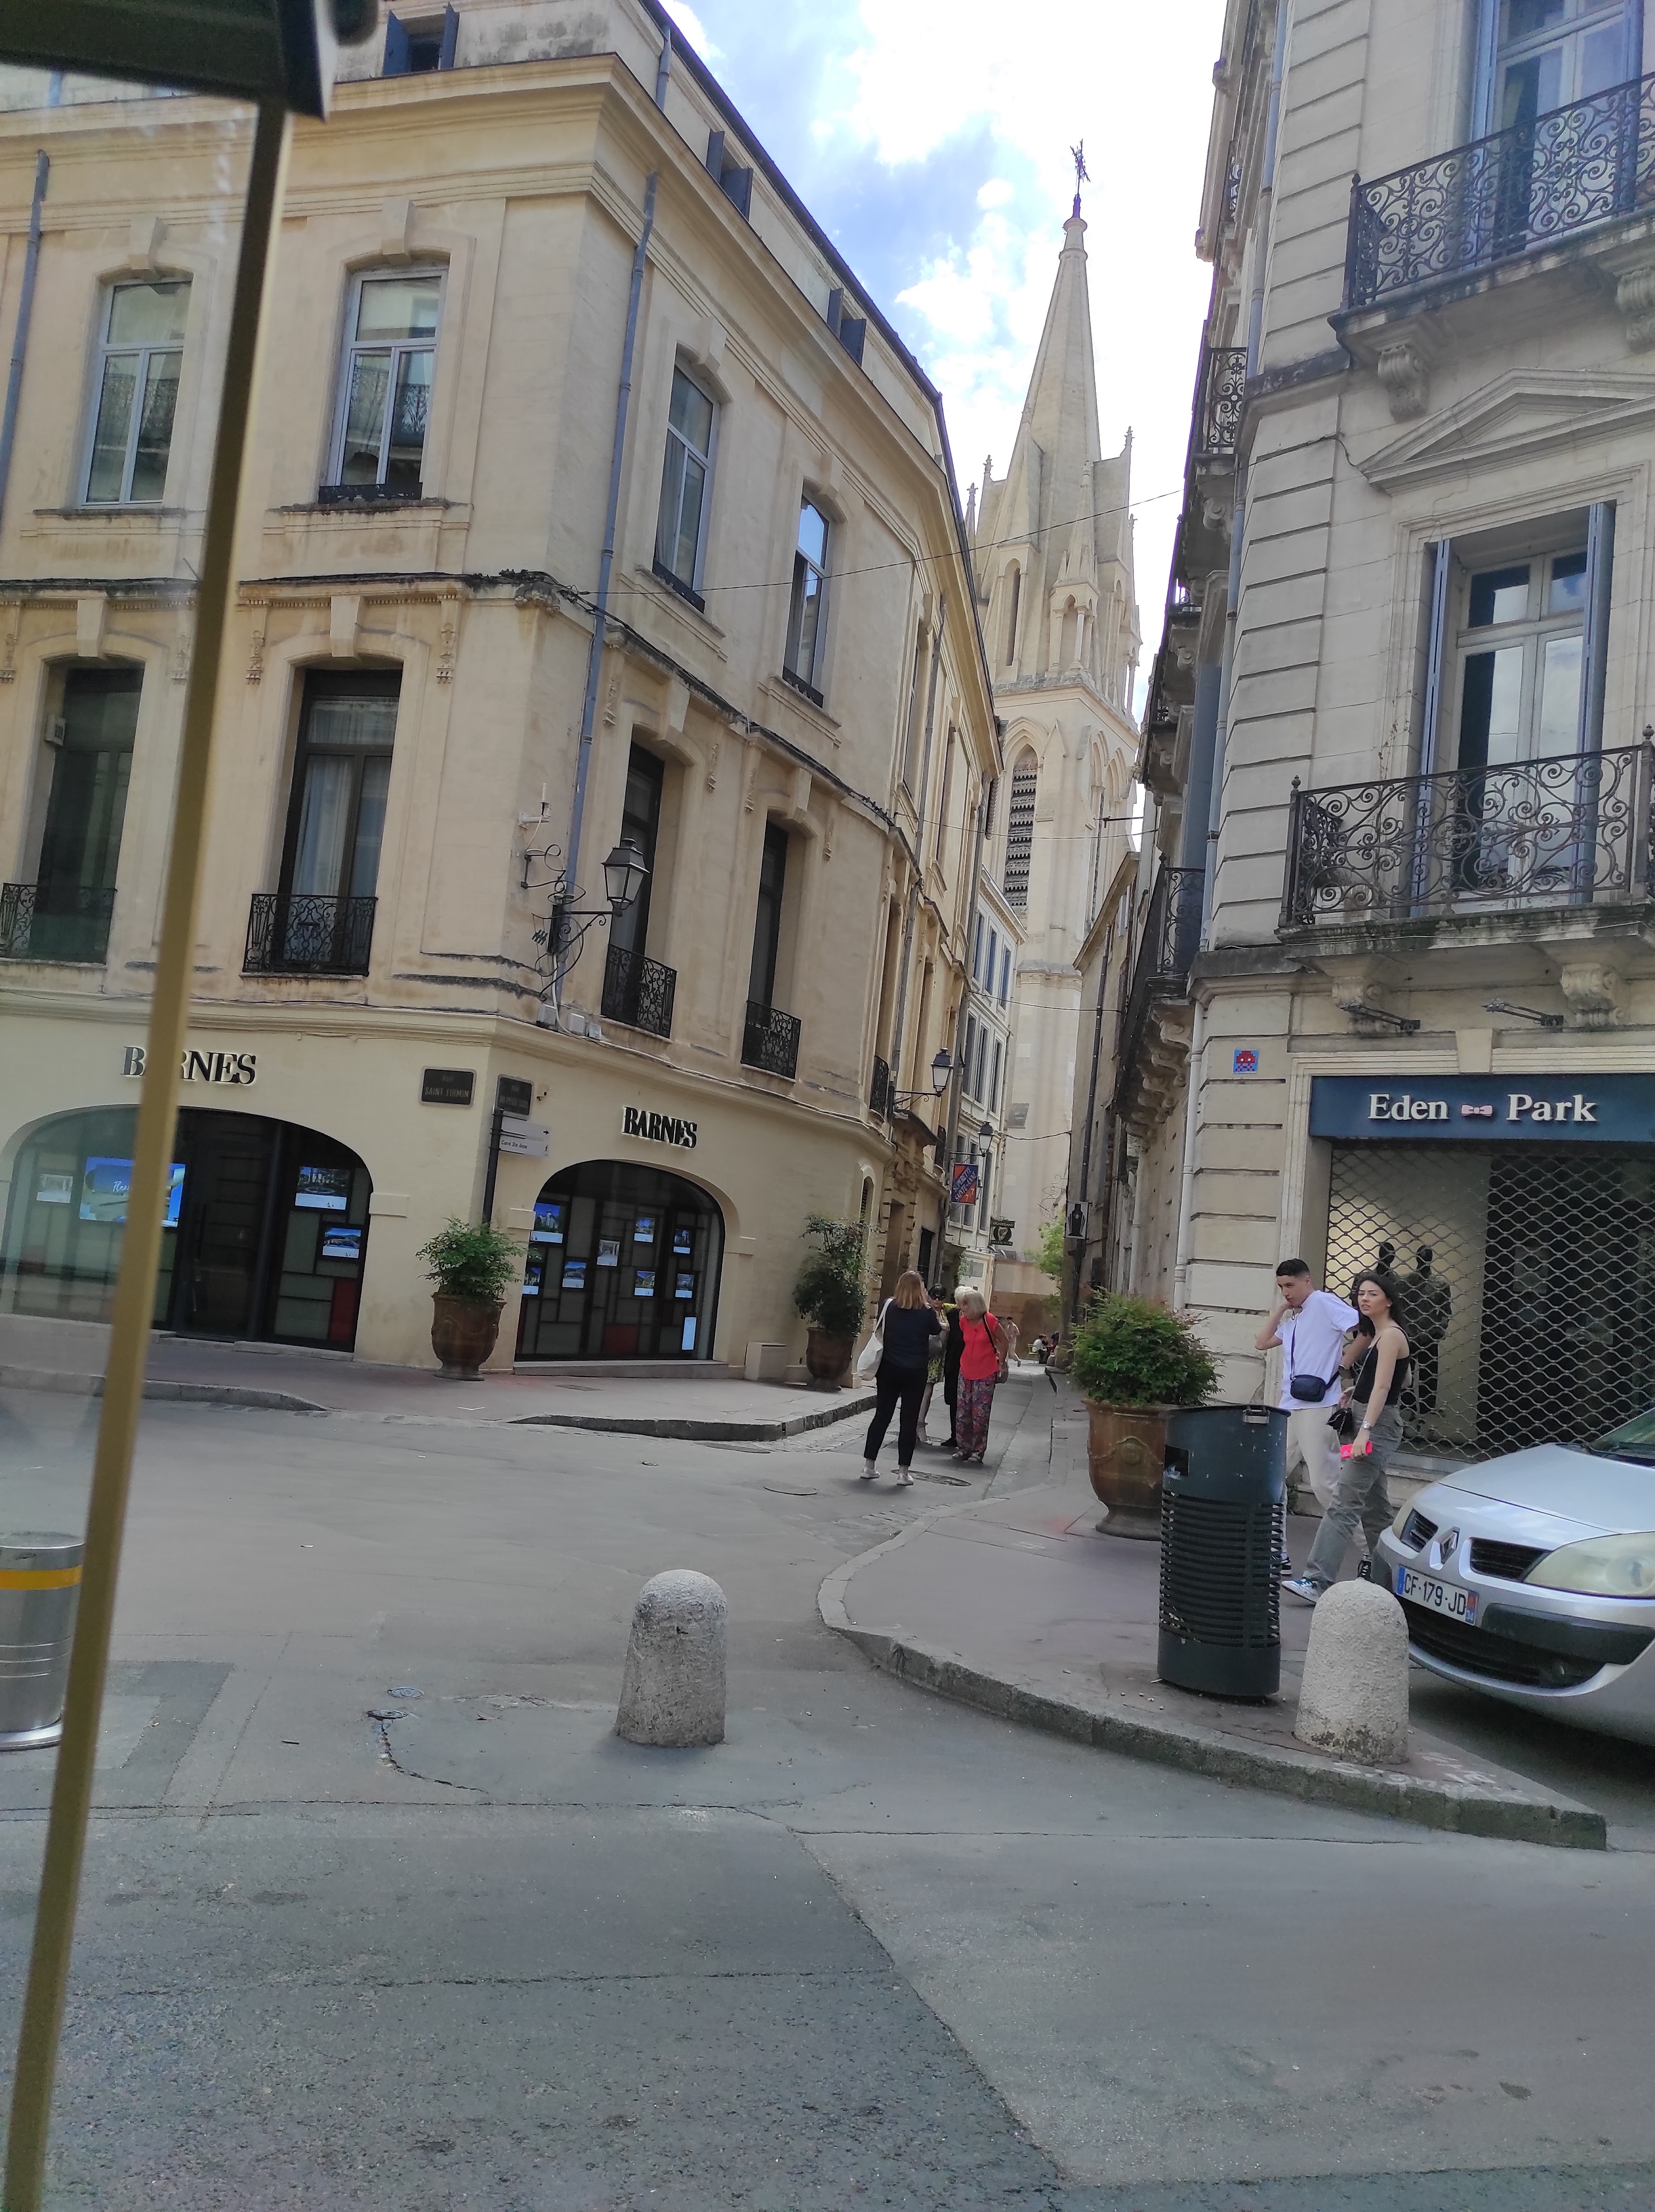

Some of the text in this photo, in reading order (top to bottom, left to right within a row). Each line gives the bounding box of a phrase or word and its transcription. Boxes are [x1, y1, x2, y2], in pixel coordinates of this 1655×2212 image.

[425, 1086, 470, 1098] SAINT FIRMIN
[1367, 1094, 1598, 1122] Eden Park
[622, 1106, 698, 1149] BARNES
